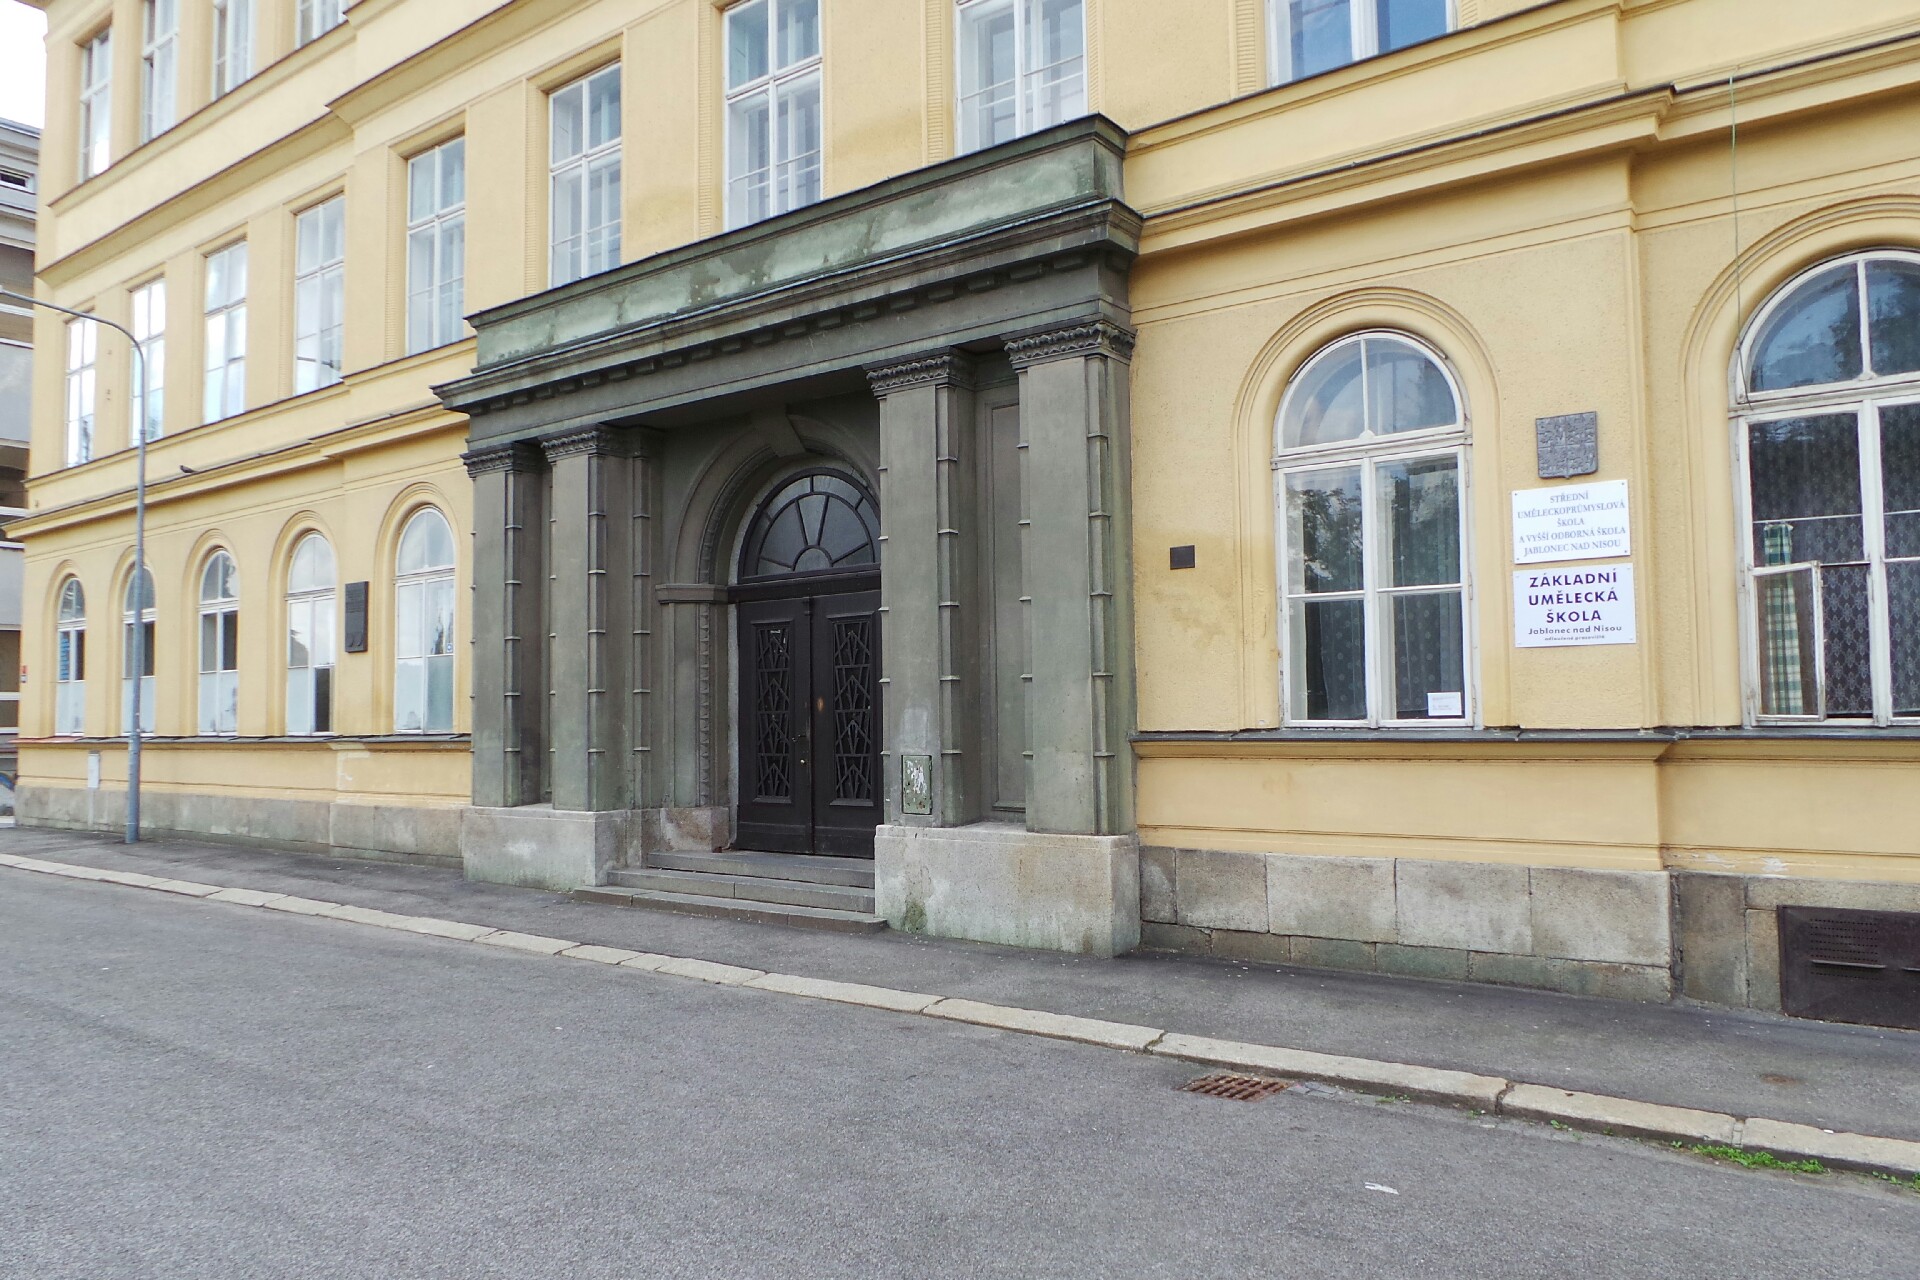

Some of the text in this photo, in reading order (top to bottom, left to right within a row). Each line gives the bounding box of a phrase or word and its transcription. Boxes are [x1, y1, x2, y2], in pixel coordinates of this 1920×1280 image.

[1550, 490, 1589, 503] STŘEDNÍ
[1557, 518, 1585, 527] ŠKOLA
[1519, 526, 1626, 543] A VYŠŠÍ ODBORNÁ ŠKOLA
[1524, 539, 1621, 557] JABLONEC NAD NISOU
[1529, 568, 1617, 588] ZÁKLADNÍ
[1528, 587, 1619, 606] UMĚLECKÁ
[1546, 609, 1602, 624] ŠKOLA
[1528, 625, 1622, 635] Jablonec nad Nisou
